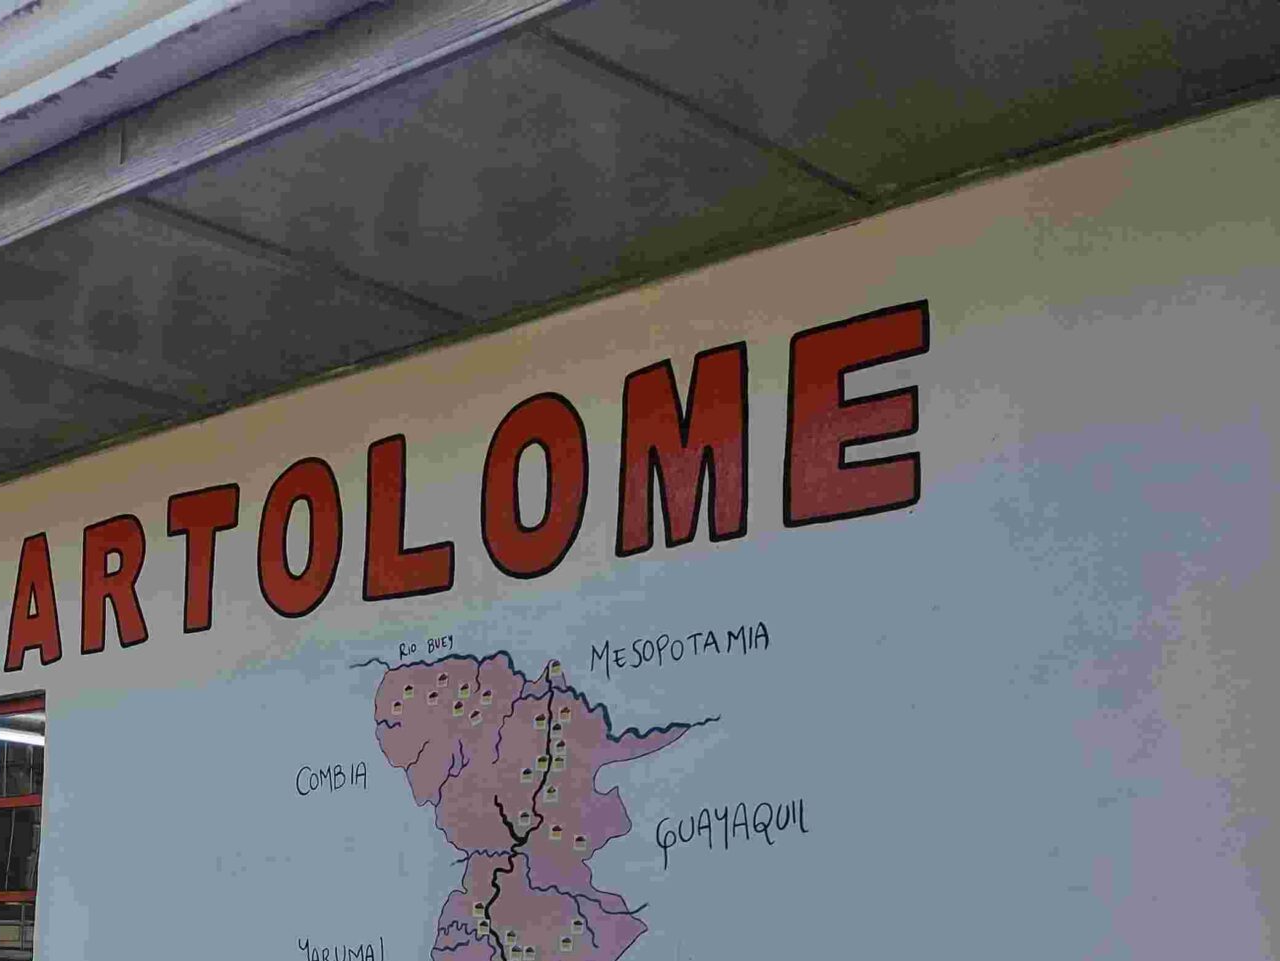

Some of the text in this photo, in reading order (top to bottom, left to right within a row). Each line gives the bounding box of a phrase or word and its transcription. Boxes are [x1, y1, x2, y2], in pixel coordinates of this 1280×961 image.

[399, 635, 453, 660] RIO BUEY
[591, 621, 770, 679] MESOPOTAMIA
[296, 762, 368, 796] COMBIA
[656, 799, 809, 869] GUAYAQUIL
